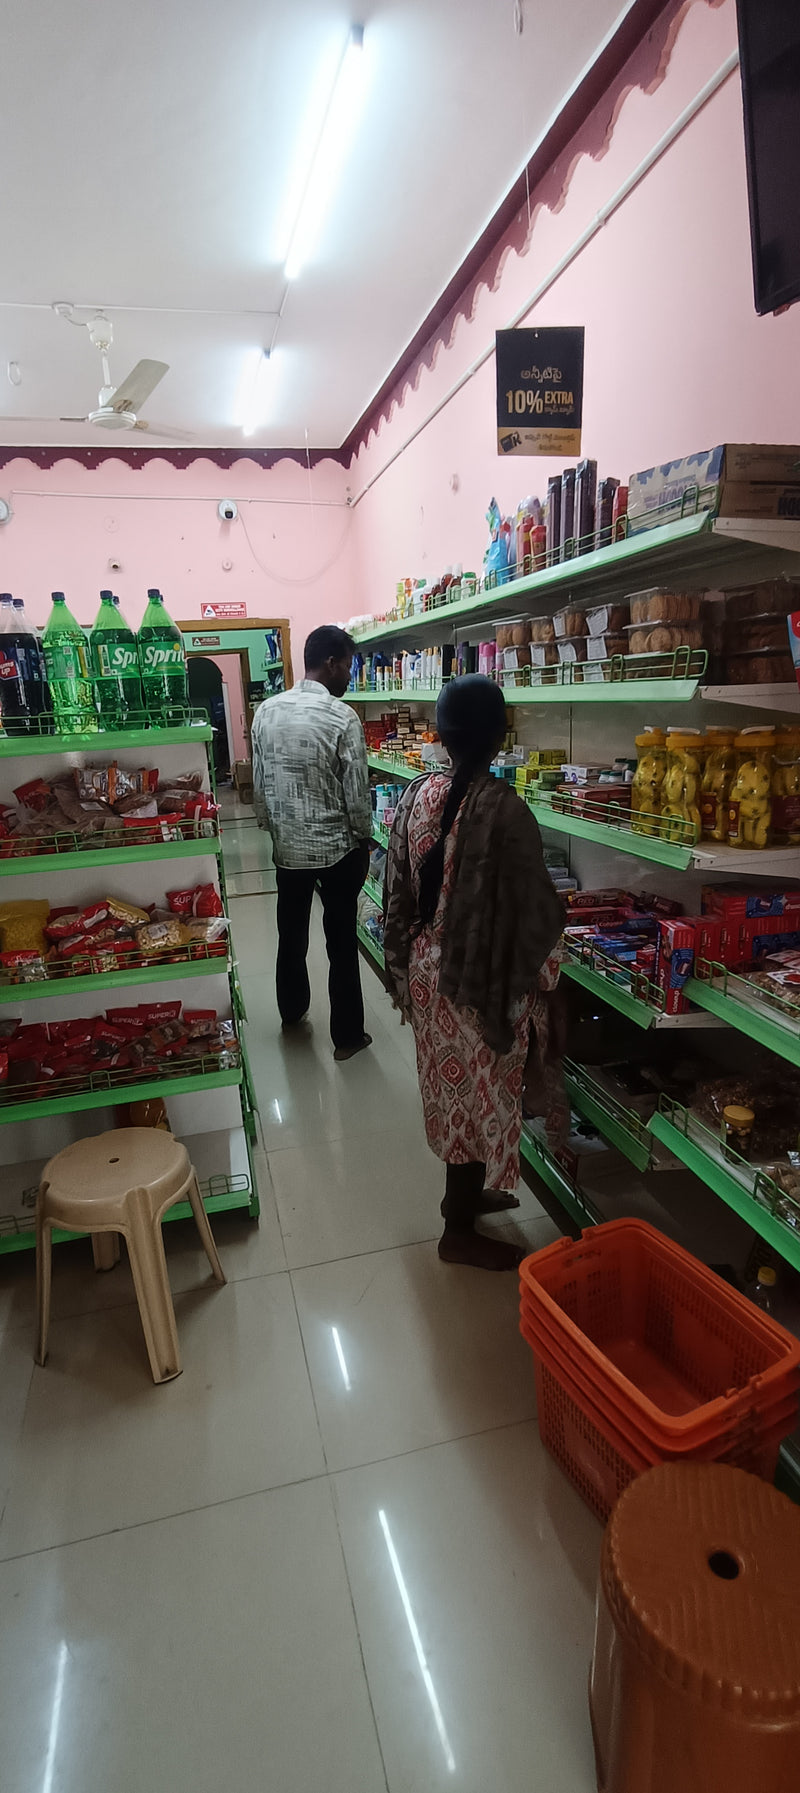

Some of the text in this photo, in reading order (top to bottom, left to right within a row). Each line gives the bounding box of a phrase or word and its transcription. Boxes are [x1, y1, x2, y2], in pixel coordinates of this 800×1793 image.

[506, 390, 543, 414] 10%
[544, 391, 574, 404] EXTRA
[173, 895, 192, 906] SUP
